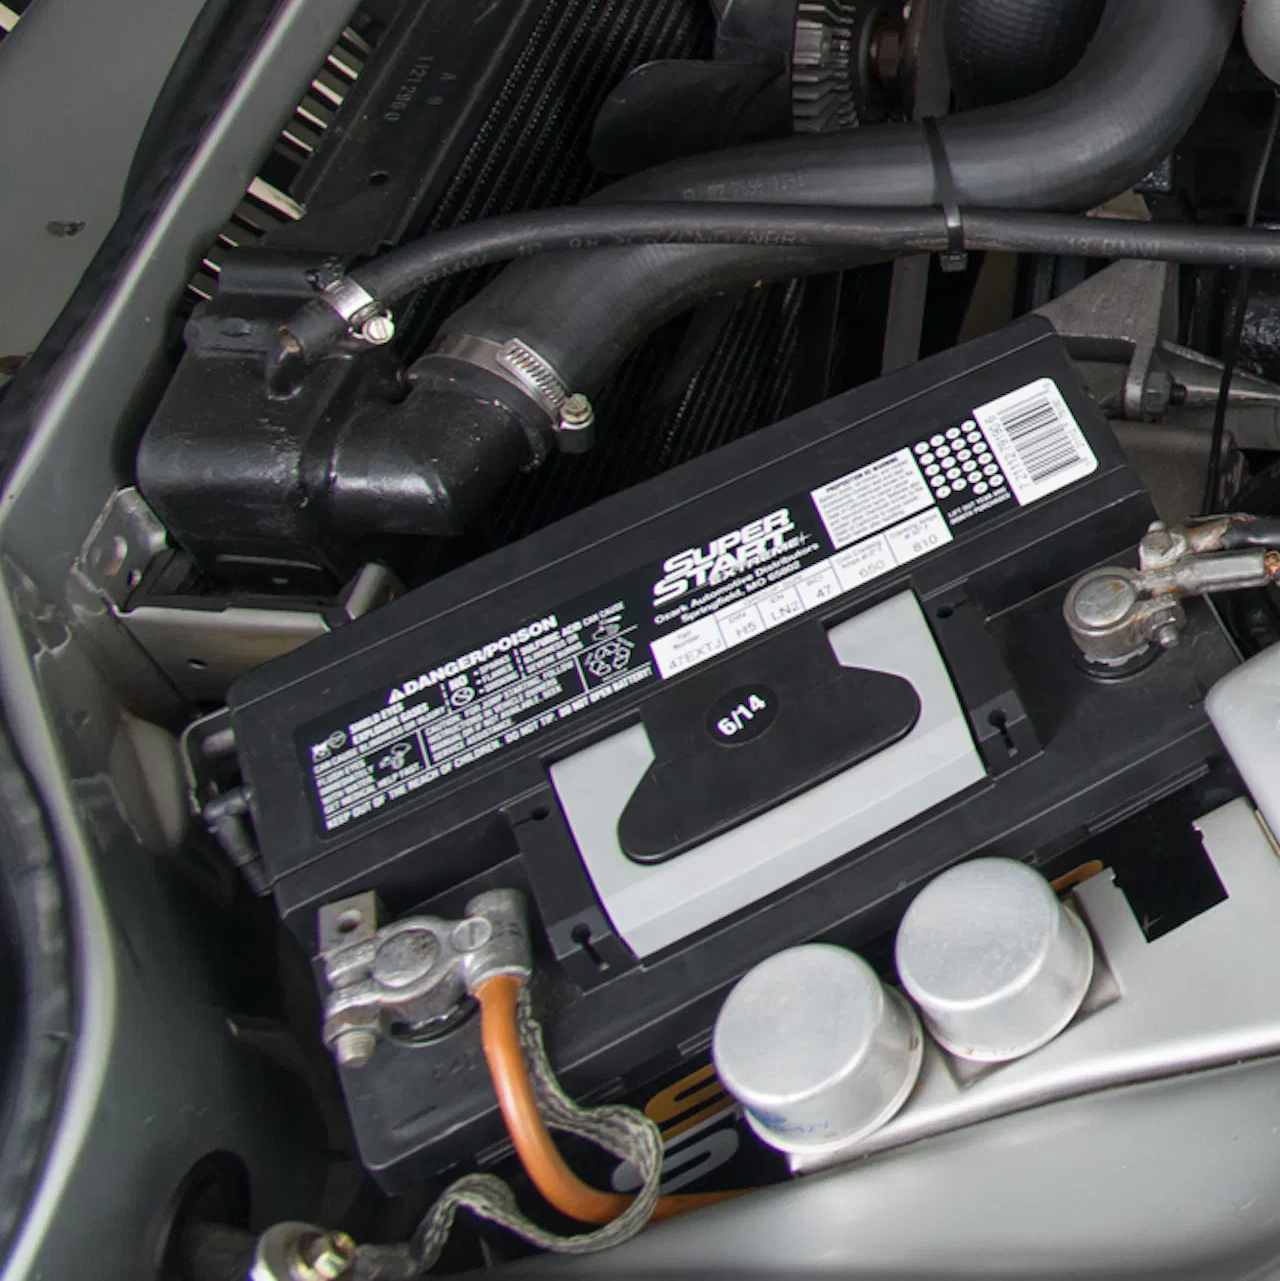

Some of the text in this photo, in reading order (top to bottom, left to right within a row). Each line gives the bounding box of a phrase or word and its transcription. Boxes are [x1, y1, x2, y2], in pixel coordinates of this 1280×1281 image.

[652, 522, 796, 607] START
[663, 507, 793, 577] SUPER
[689, 571, 753, 608] Automotive
[754, 540, 819, 577] Distributors
[815, 584, 832, 599] 47
[402, 614, 559, 697] DANGER/POISON
[717, 693, 766, 736] 6/14
